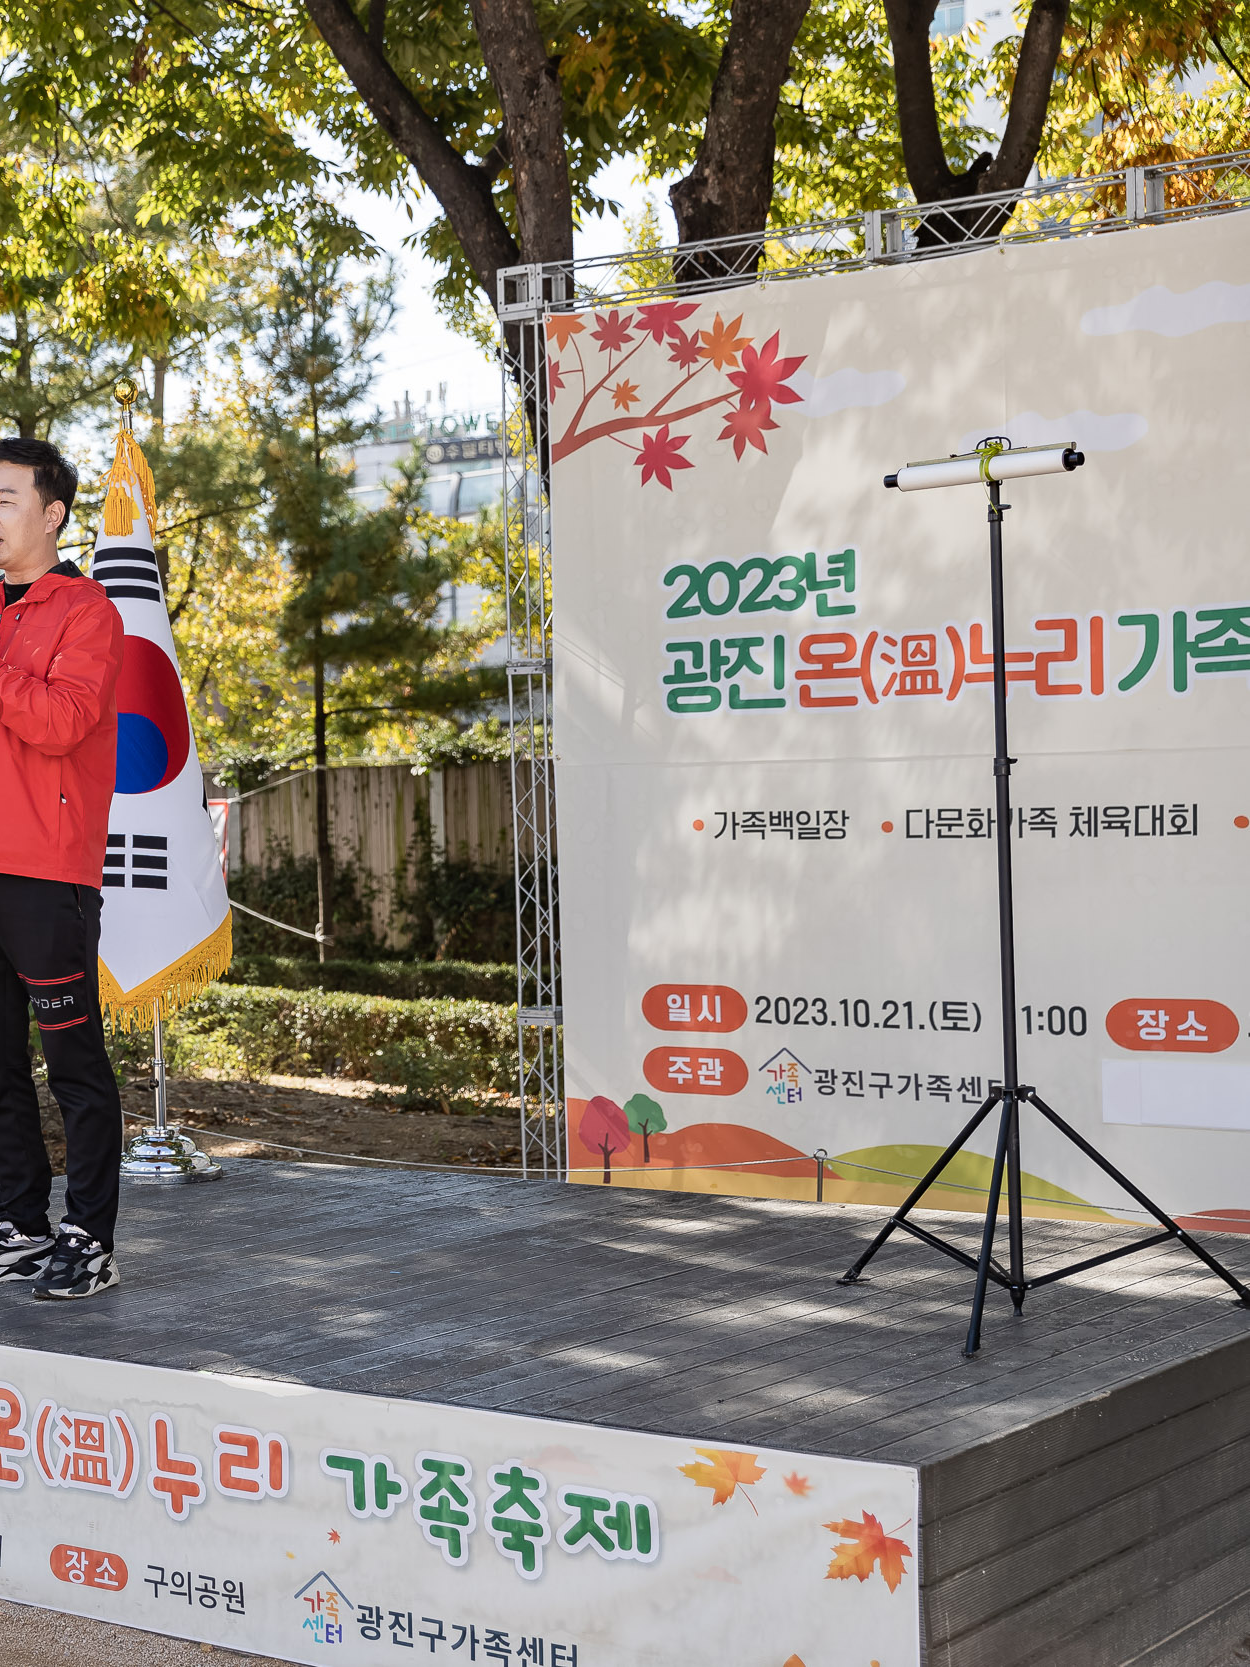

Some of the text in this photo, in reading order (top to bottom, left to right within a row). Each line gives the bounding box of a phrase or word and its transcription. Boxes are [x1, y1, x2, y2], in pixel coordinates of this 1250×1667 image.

[663, 548, 856, 619] 2023년
[663, 634, 786, 713] 광진
[714, 809, 850, 840] 가족백일장
[1069, 803, 1198, 837] 체육대회
[666, 993, 723, 1024] 일시
[754, 995, 983, 1034] 2023.10.21.(토)
[1136, 1009, 1209, 1042] 장소
[667, 1055, 725, 1087] 주관
[766, 1063, 800, 1089] 가족
[766, 1081, 802, 1105] 센터
[325, 1456, 653, 1572] 가족축제
[65, 1550, 119, 1588] 장소
[143, 1563, 246, 1615] 구의공원
[356, 1603, 579, 1667] 광진구가족센터
[302, 1590, 340, 1625] 가족
[302, 1613, 344, 1645] 센터
